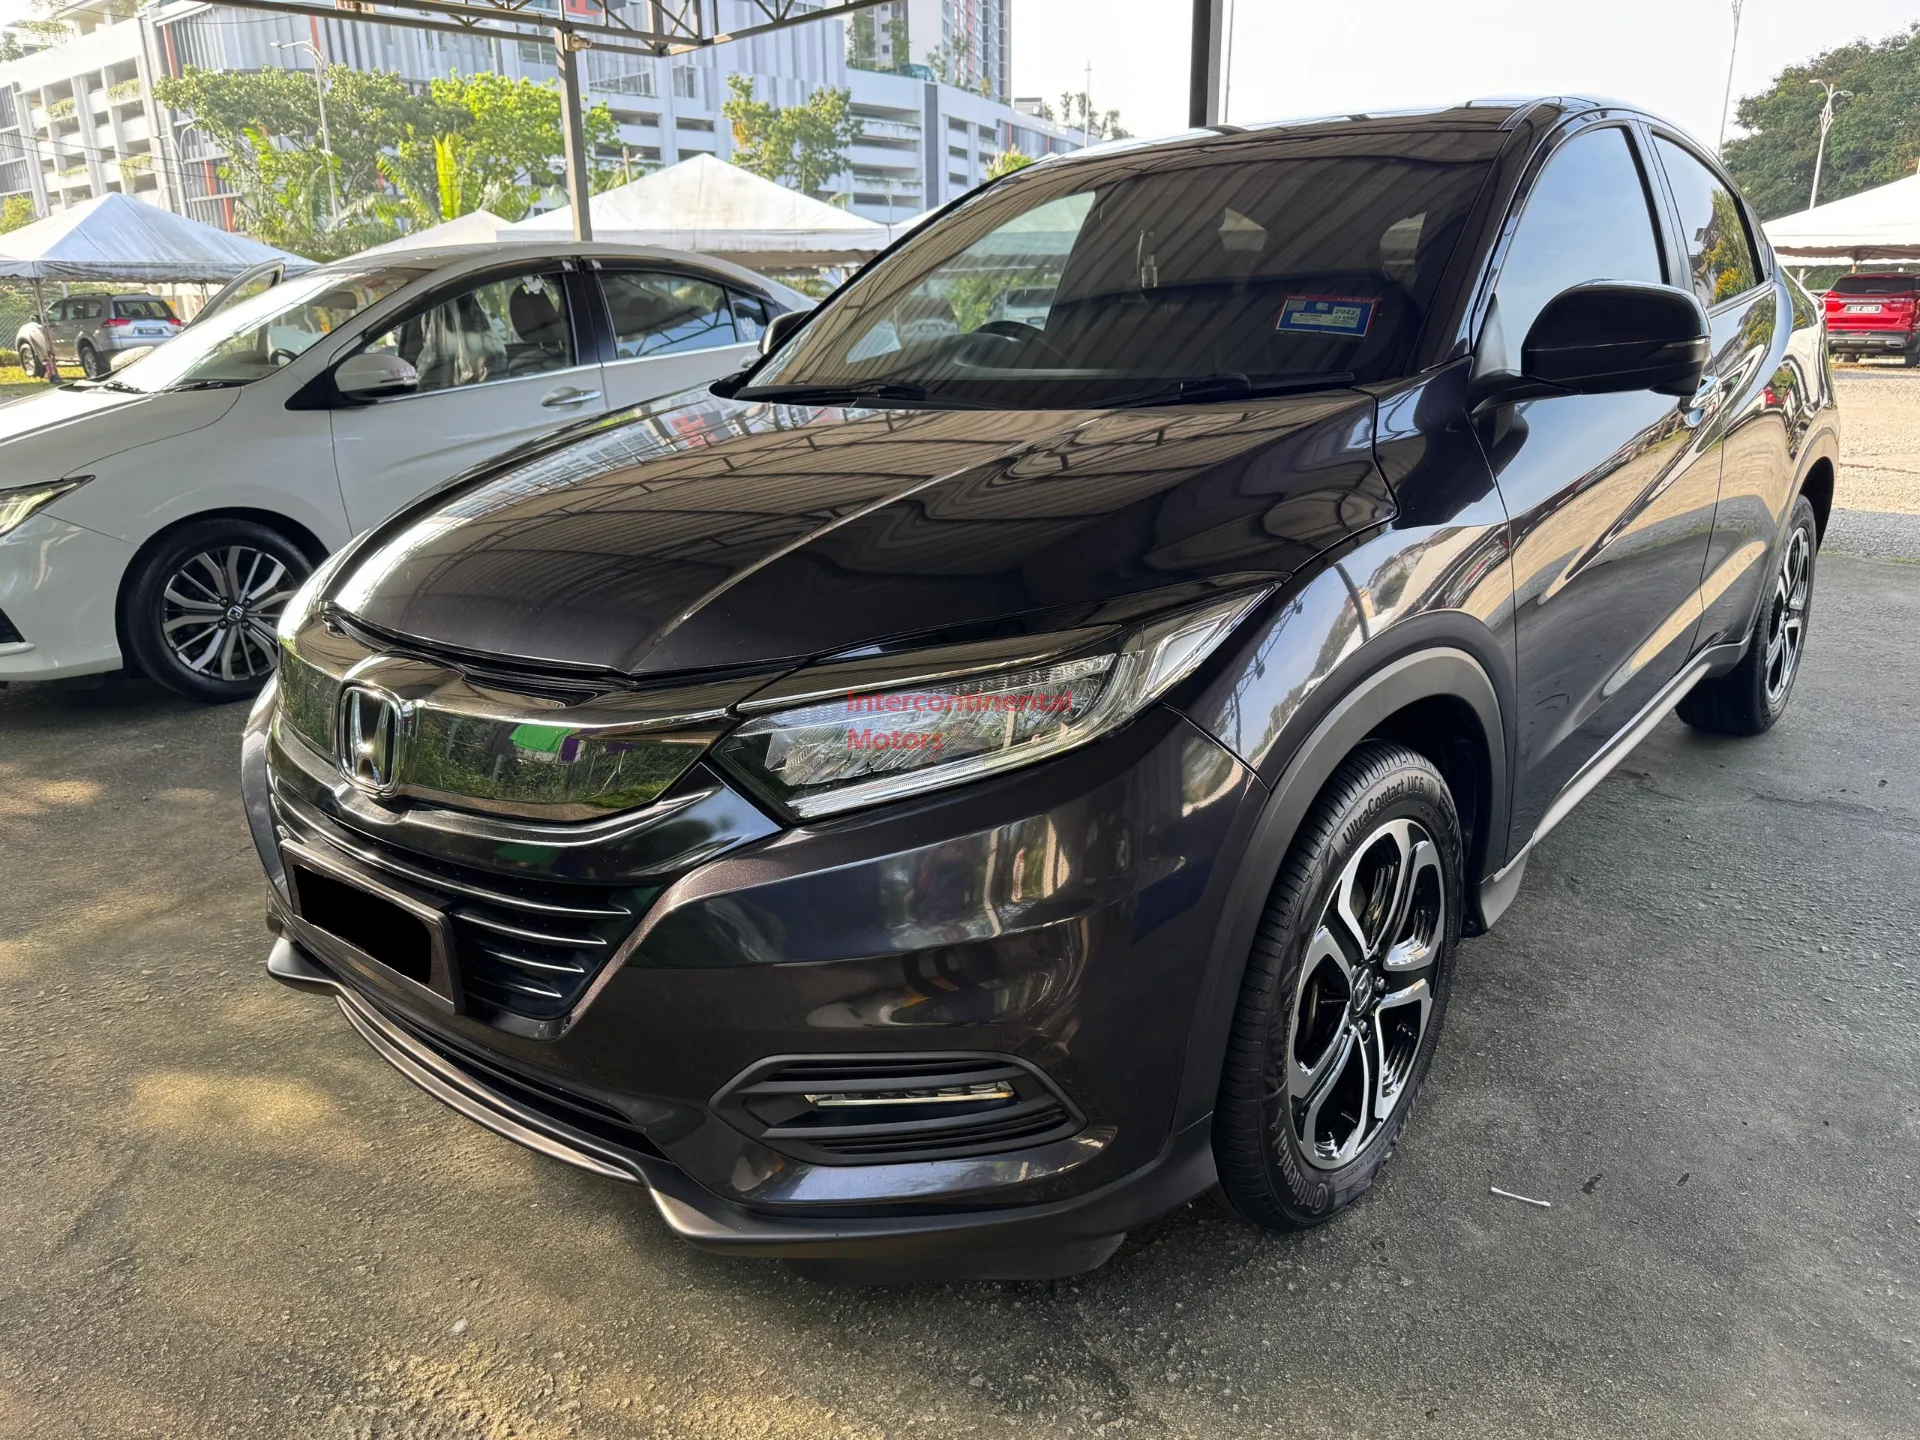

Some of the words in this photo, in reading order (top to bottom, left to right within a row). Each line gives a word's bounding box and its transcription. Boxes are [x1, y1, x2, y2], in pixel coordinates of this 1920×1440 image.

[1341, 778, 1405, 846] UltraContact
[1407, 776, 1425, 794] UC6
[1271, 1126, 1329, 1215] Continental
